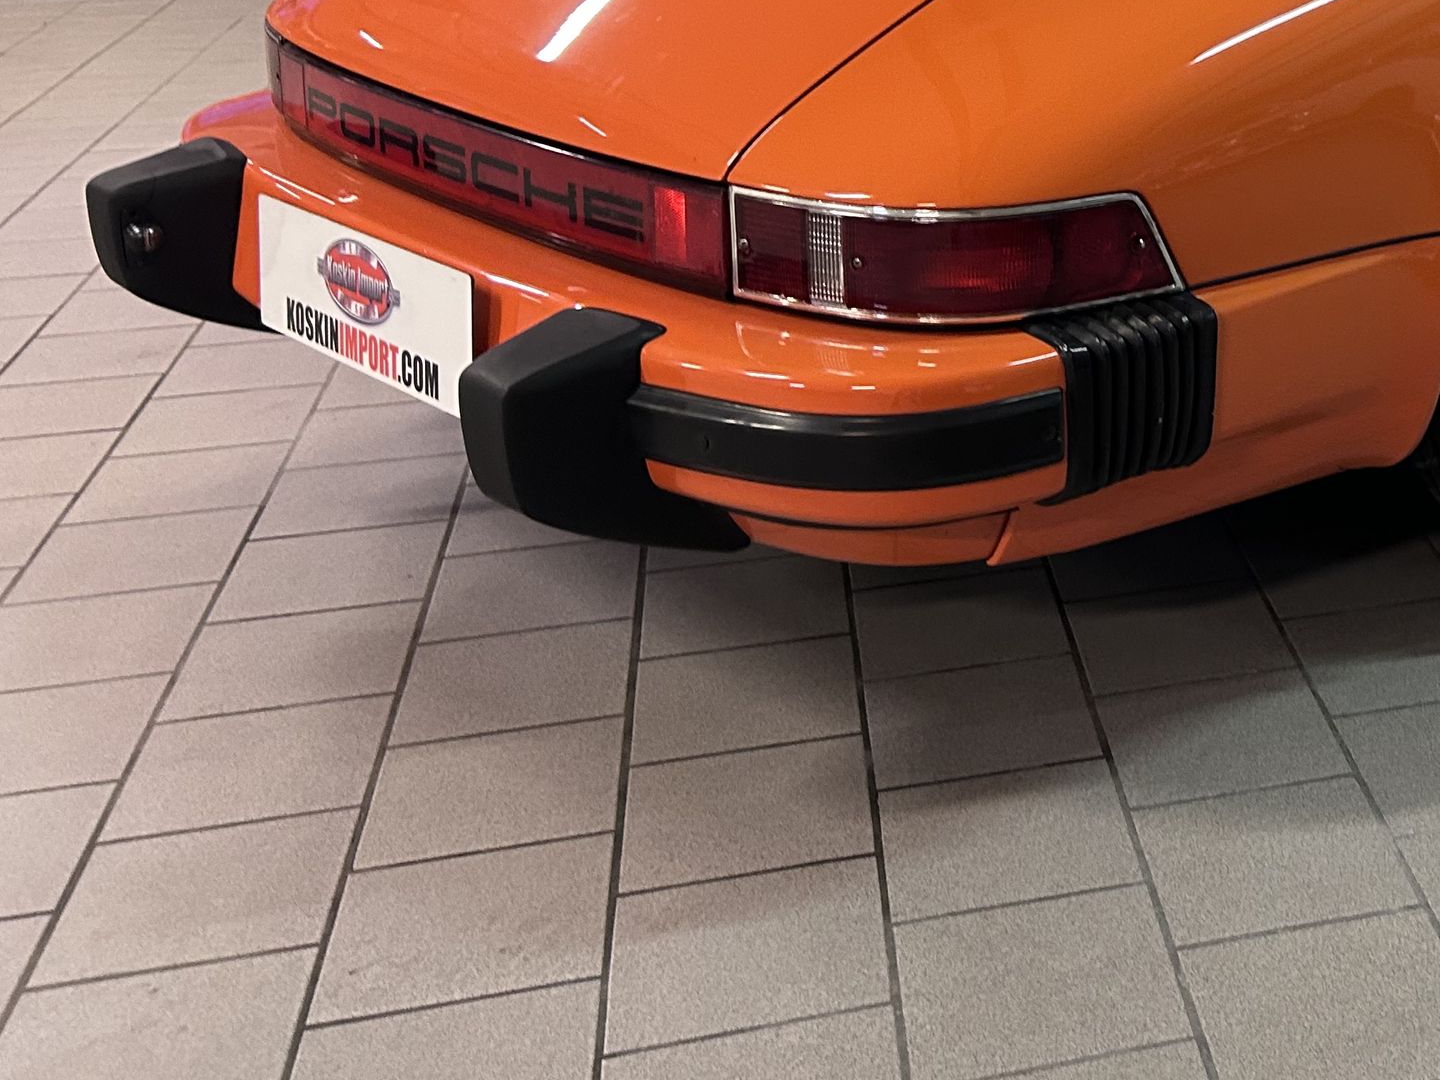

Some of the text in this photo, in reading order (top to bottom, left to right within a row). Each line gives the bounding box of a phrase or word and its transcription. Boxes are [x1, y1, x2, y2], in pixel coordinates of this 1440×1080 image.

[307, 86, 644, 243] PORSCHE
[326, 254, 390, 305] Koskin Import
[286, 296, 440, 401] KOSKINIMPORT.COM
